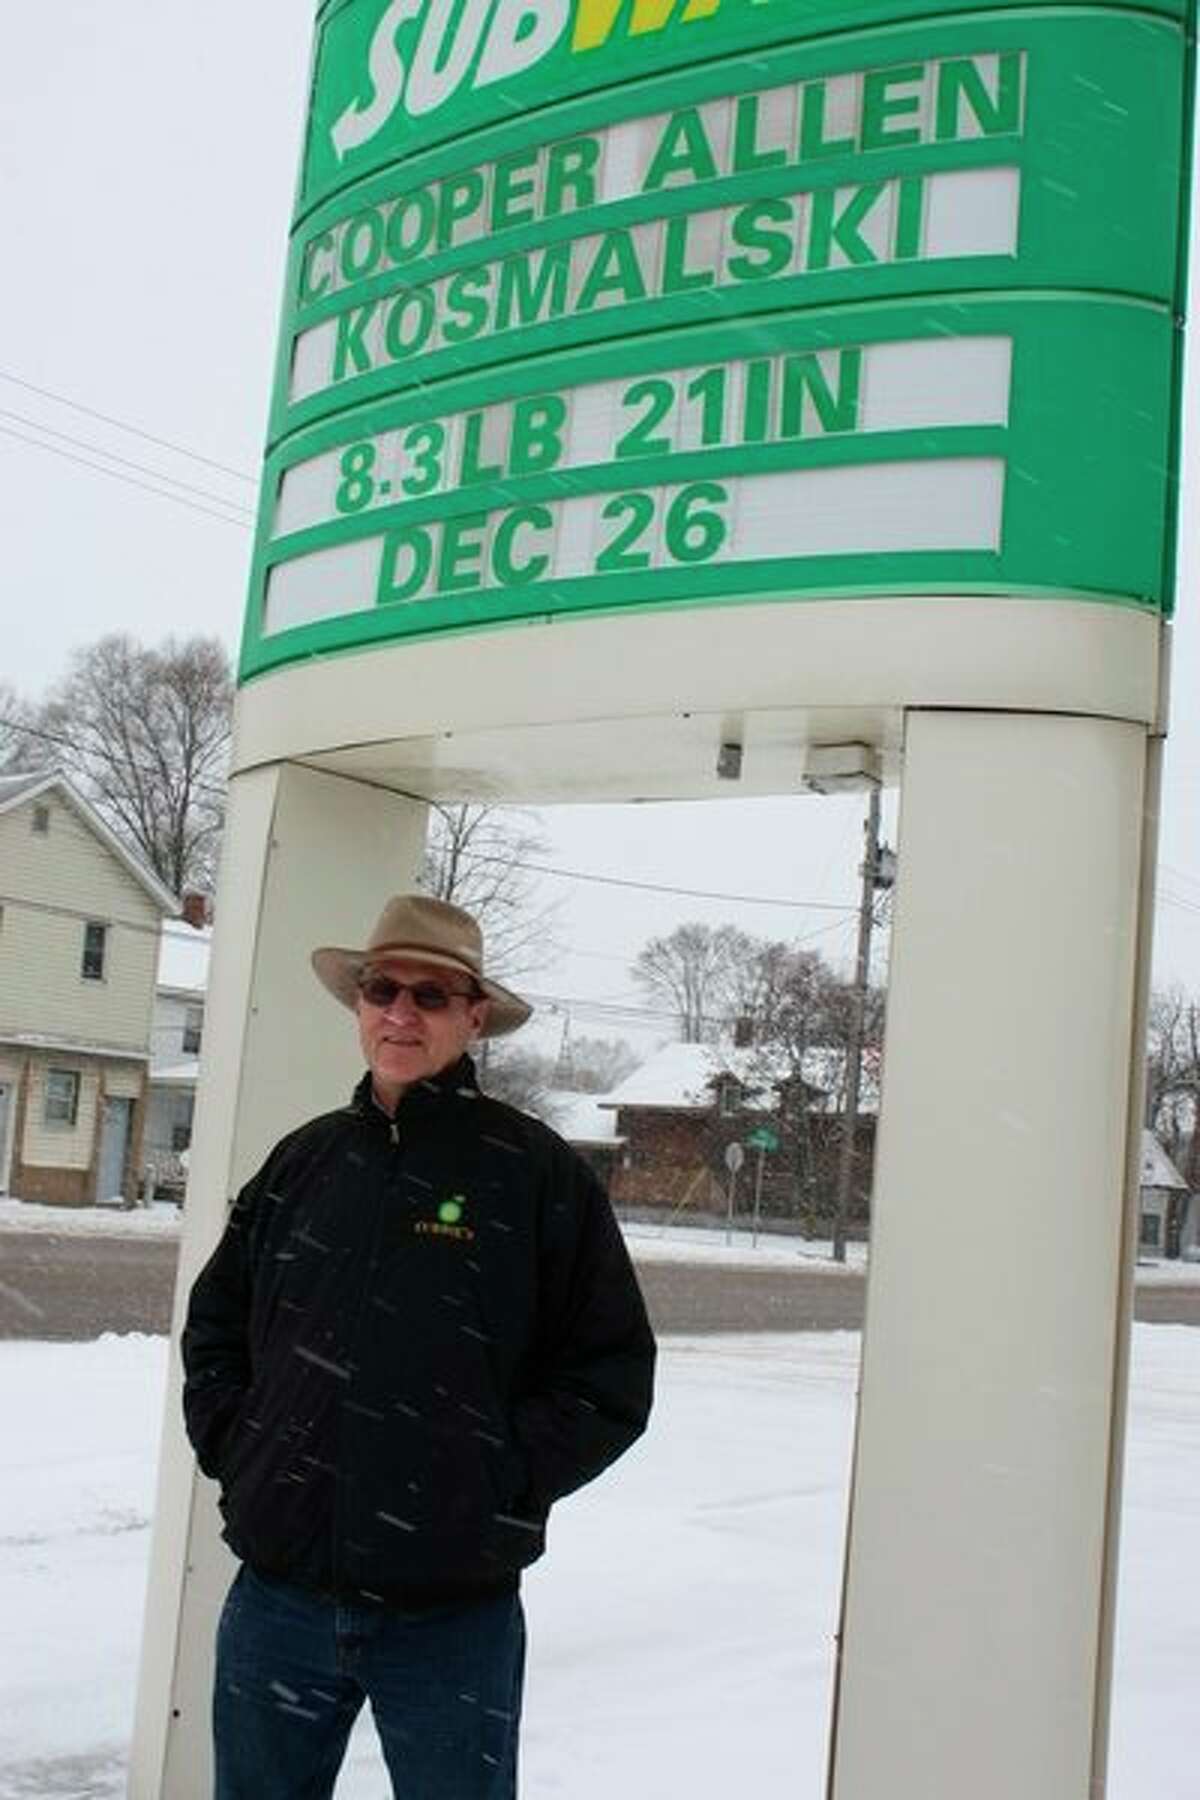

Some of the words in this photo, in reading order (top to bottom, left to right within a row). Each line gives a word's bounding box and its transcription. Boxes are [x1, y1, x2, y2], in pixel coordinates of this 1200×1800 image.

[303, 134, 600, 302] COOPER
[642, 56, 1020, 190] ALLEN
[332, 176, 924, 381] KOSMALSKI
[336, 395, 569, 514] 8.3LB
[614, 350, 862, 460] 21IN
[376, 492, 553, 604] DEC
[595, 481, 728, 573] 26
